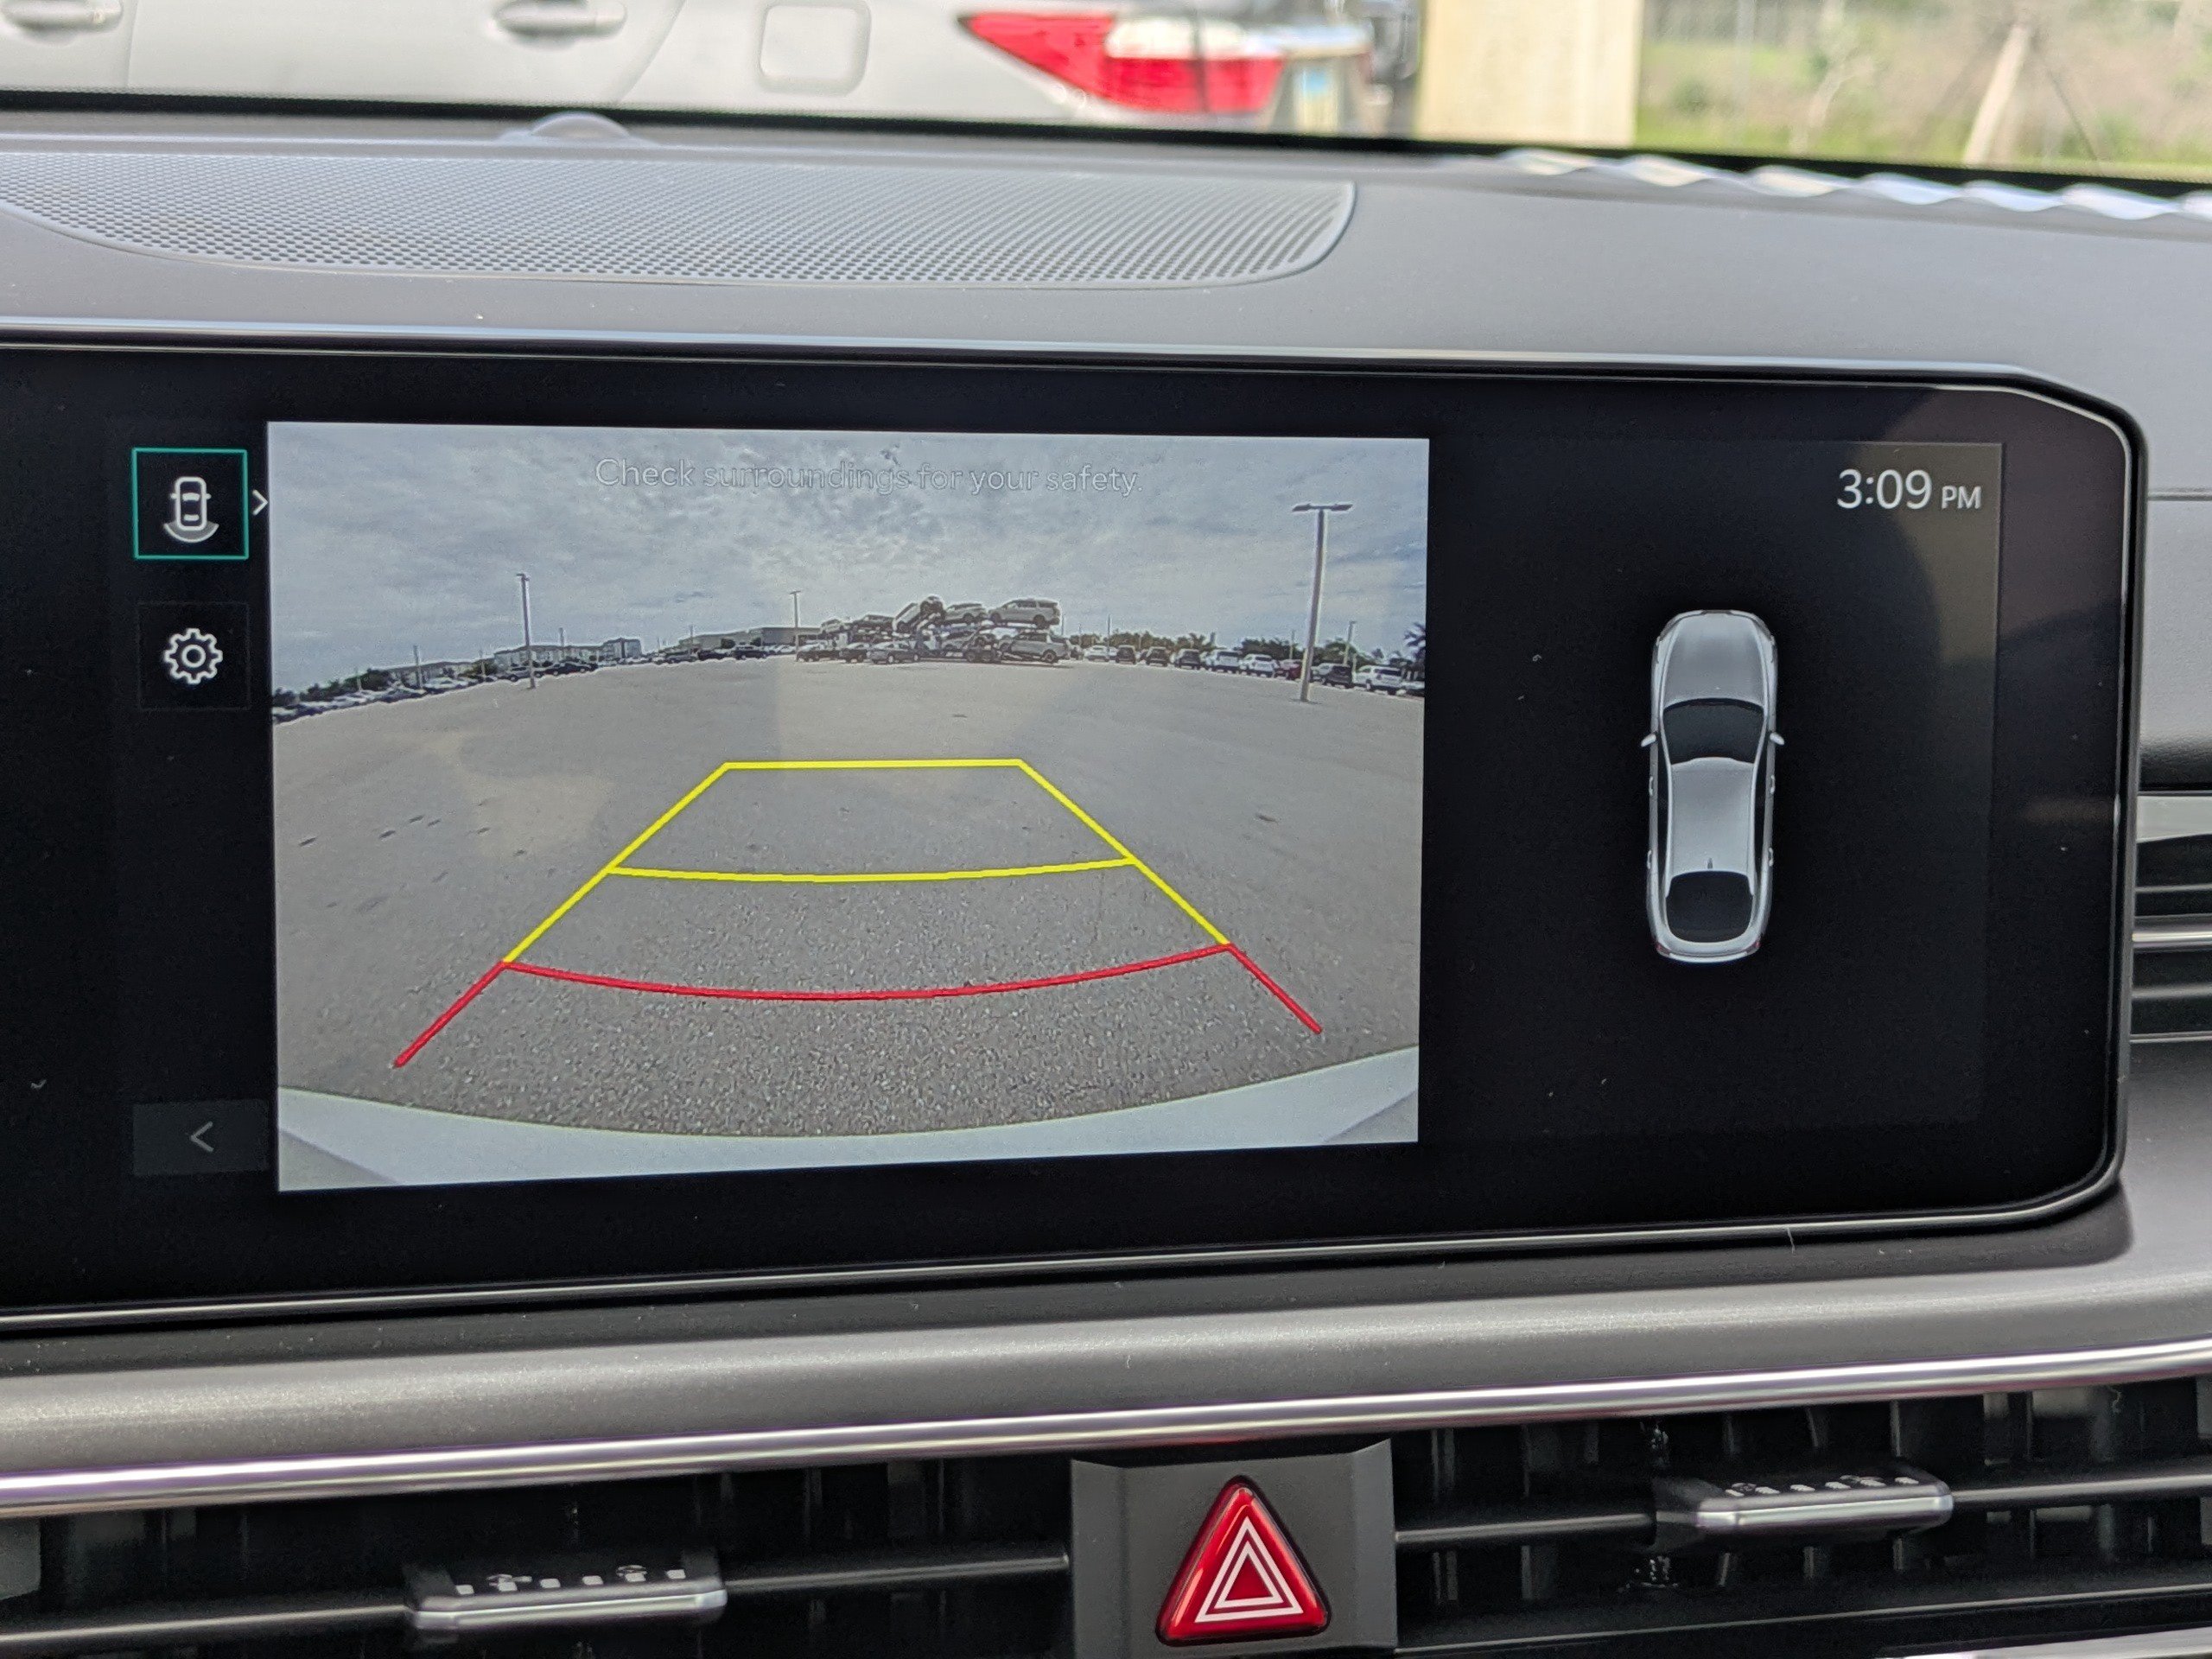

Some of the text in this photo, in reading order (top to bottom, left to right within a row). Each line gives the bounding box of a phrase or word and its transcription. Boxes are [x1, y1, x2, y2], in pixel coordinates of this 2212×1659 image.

[595, 457, 1143, 497] Check surroundings for your safety.
[1837, 468, 1982, 510] 3:09 PM
